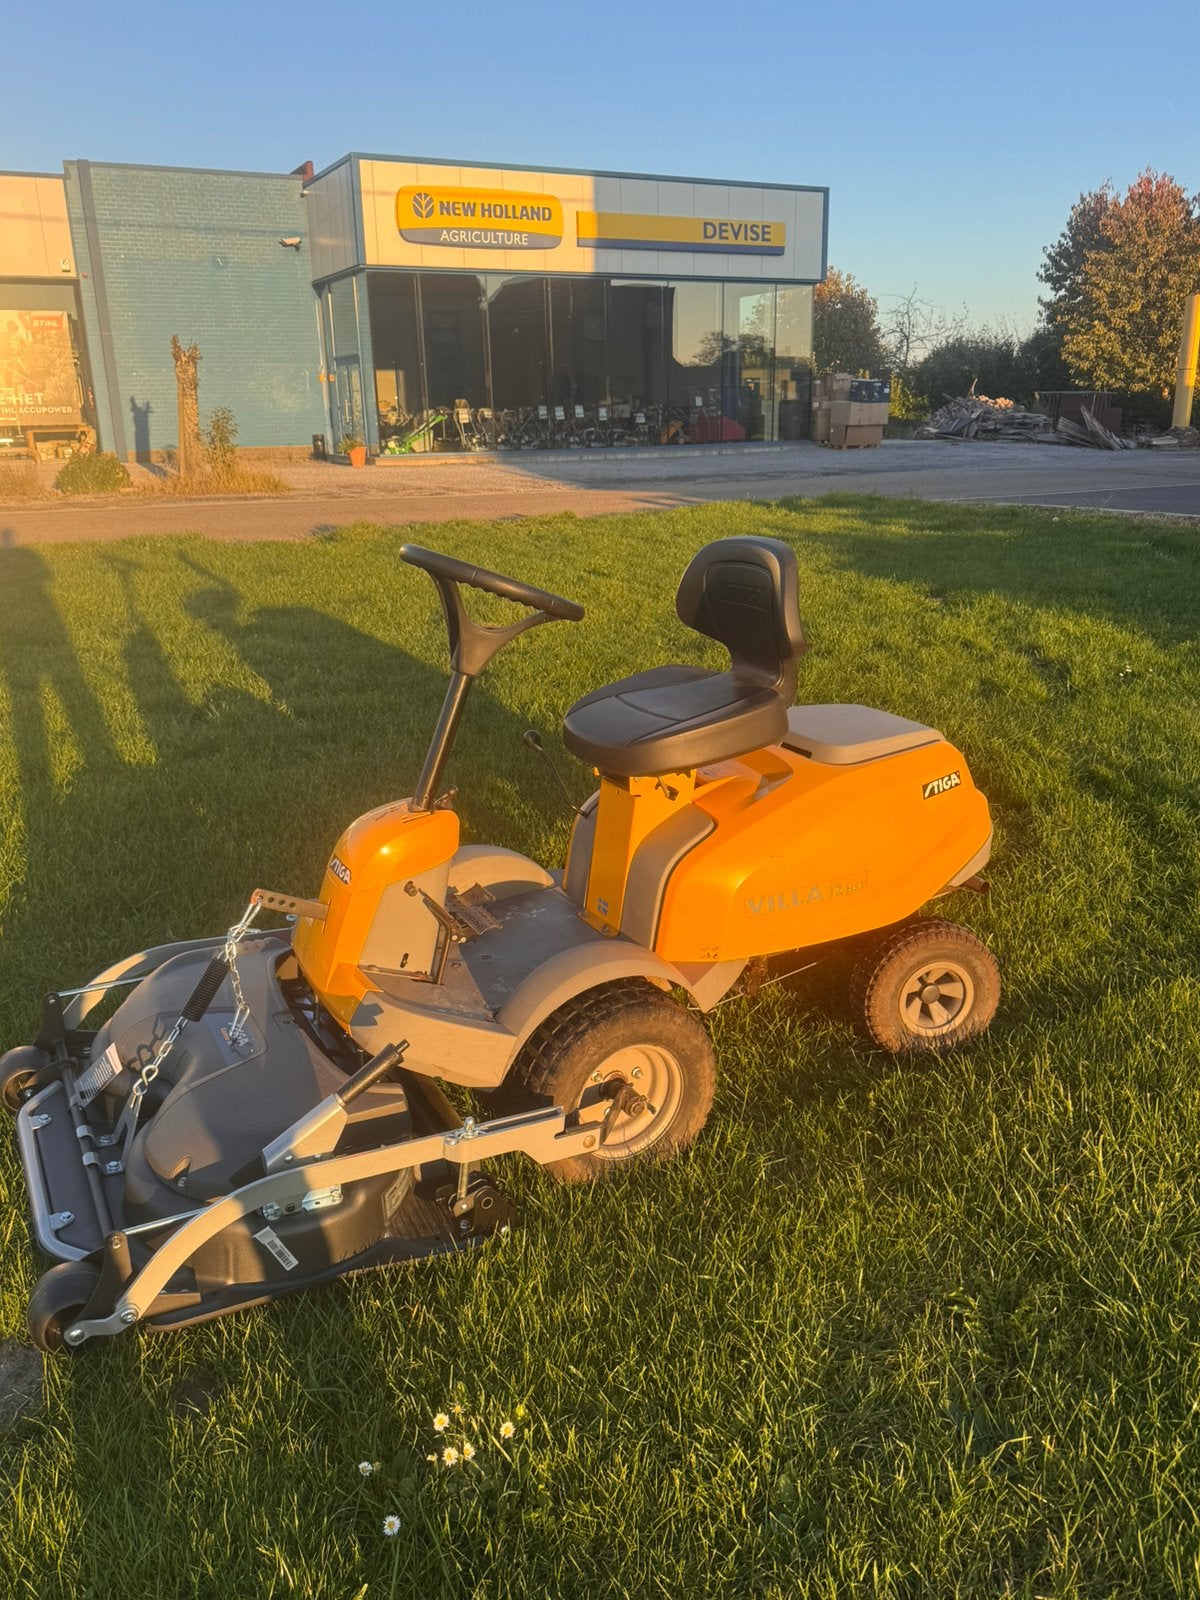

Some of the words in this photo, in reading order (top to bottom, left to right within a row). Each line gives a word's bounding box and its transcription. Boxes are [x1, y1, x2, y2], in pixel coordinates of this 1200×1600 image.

[439, 200, 477, 217] NEW
[481, 202, 553, 222] HOLLAND
[440, 229, 529, 246] AGRICULTURE
[702, 221, 772, 242] DEVISE
[32, 319, 60, 328] STIHL
[12, 391, 45, 406] HET
[1, 406, 17, 415] IHL
[19, 405, 73, 415] ACCUPOWER
[923, 771, 961, 799] STIGA
[330, 857, 351, 885] STIGA
[747, 886, 825, 915] VILLA
[828, 883, 843, 898] 12
